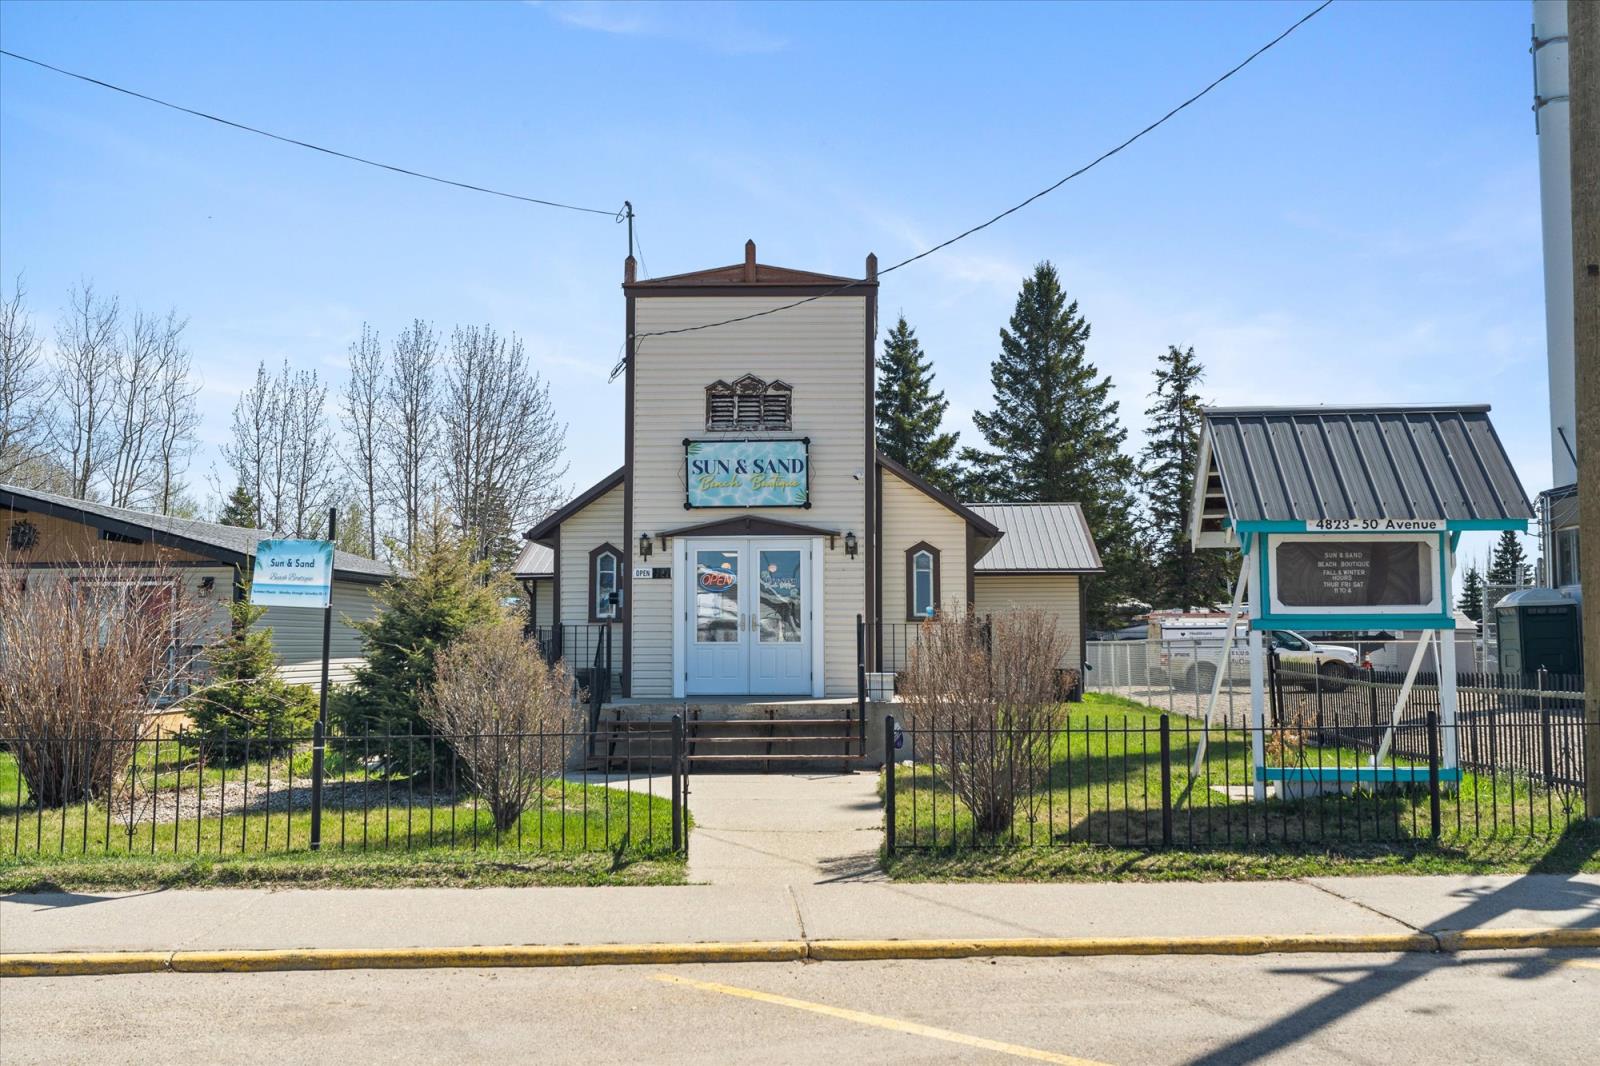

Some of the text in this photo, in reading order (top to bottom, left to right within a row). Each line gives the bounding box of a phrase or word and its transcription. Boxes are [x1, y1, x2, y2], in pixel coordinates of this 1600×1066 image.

[692, 458, 804, 475] SUN & SAND
[700, 474, 742, 491] Beach
[1316, 519, 1350, 530] 4823
[1361, 519, 1379, 530] 50
[1385, 519, 1437, 530] Avenue
[270, 558, 315, 568] Sun & Sand
[635, 569, 651, 577] OPEN
[702, 574, 734, 587] OPEN
